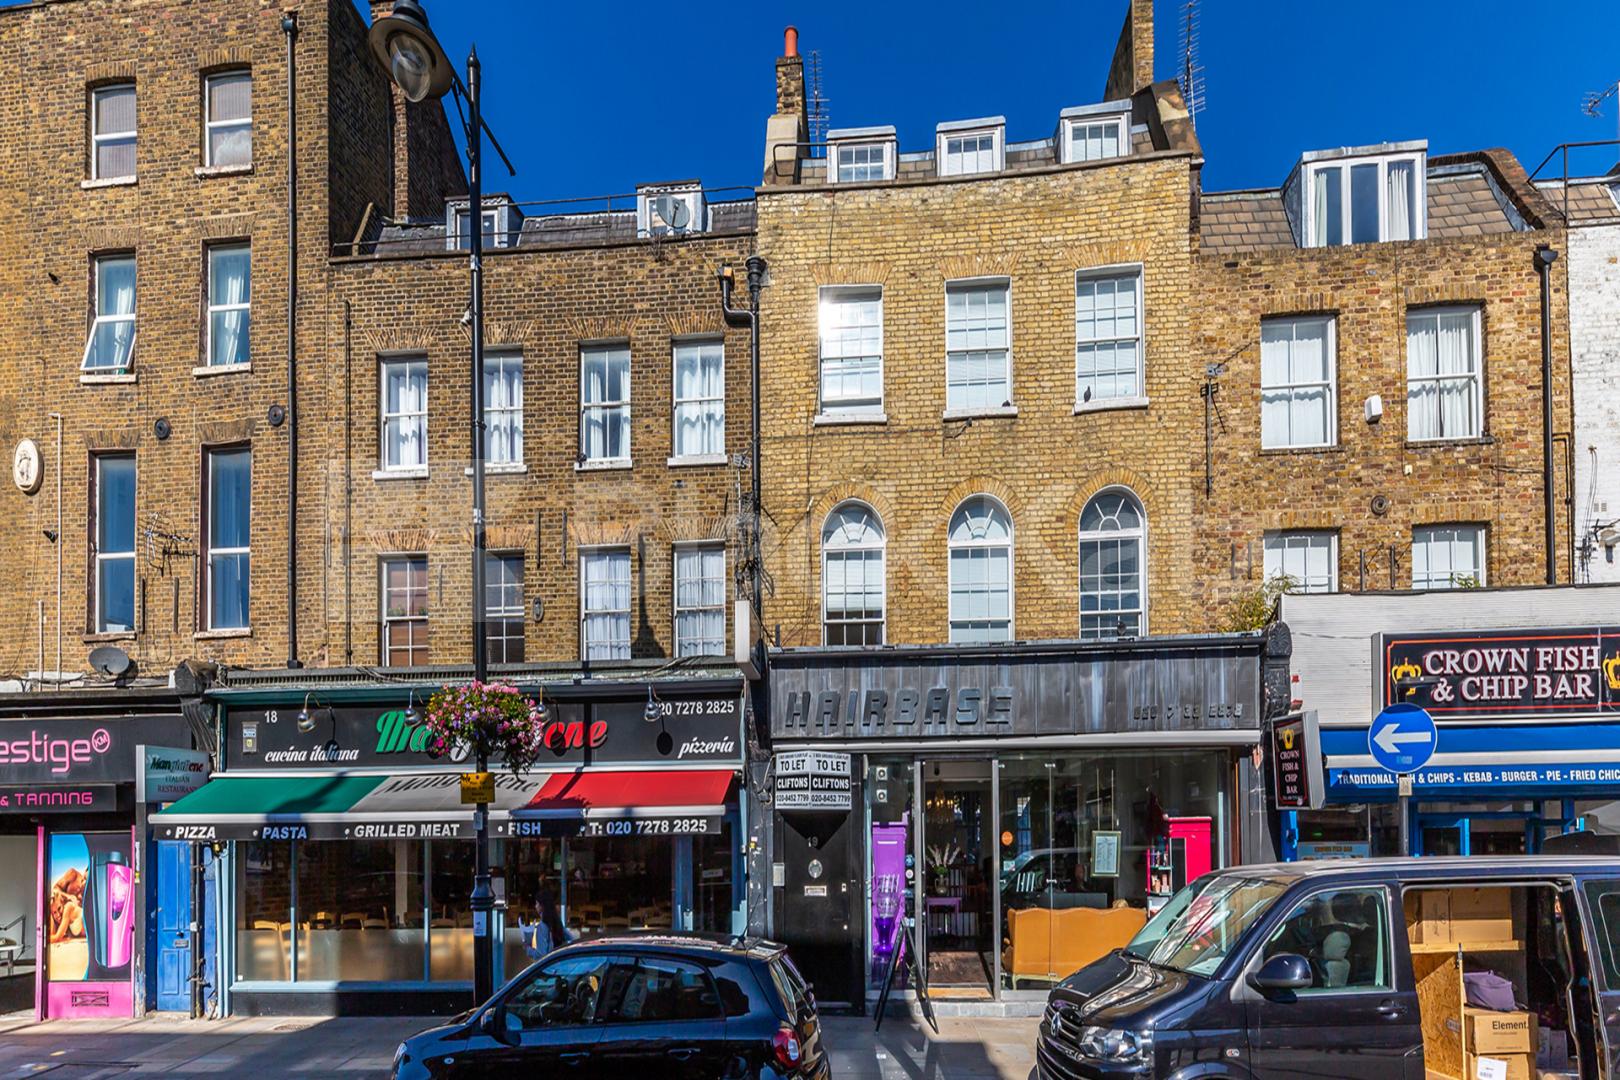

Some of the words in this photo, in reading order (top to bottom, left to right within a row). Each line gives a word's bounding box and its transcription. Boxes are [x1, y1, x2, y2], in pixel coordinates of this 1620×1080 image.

[1424, 648, 1529, 675] CROWN
[1536, 646, 1601, 672] FISH
[1432, 678, 1455, 701] &
[1460, 675, 1528, 700] CHIP
[1533, 674, 1595, 699] BAR
[675, 702, 703, 715] 7278
[706, 700, 735, 714] 2825
[785, 687, 1014, 727] HAIRBASE
[264, 710, 278, 724] 18
[264, 745, 308, 762] cucina
[309, 743, 360, 762] italiana
[677, 735, 735, 759] pizzeria
[1280, 750, 1299, 760] CROWN
[781, 761, 790, 771] TO
[792, 760, 806, 770] LET
[816, 760, 828, 771] TO
[831, 761, 846, 771] LET
[1282, 762, 1293, 771] FISH
[777, 777, 808, 789] CLIFTONS
[812, 778, 849, 789] CLIFTONS
[1285, 774, 1298, 783] CHIP
[1337, 773, 1394, 785] TRADITIONAL
[1418, 773, 1425, 783] &
[1427, 772, 1454, 783] CHIPS
[1463, 772, 1492, 783] KEBAB
[1501, 770, 1538, 782] BURGER
[1546, 770, 1561, 781] PIE
[1570, 769, 1596, 781] FRIED
[1286, 786, 1298, 794] BAR
[0, 796, 9, 807] &
[14, 792, 93, 806] TANNING
[175, 826, 216, 839] PIZZA
[262, 826, 307, 840] PASTA
[354, 824, 416, 838] GRILLED
[420, 823, 460, 837] MEAT
[508, 822, 541, 835] FISH
[589, 822, 603, 835] T:
[606, 821, 632, 834] 020
[635, 820, 669, 833] 7278
[673, 819, 707, 833] 2825
